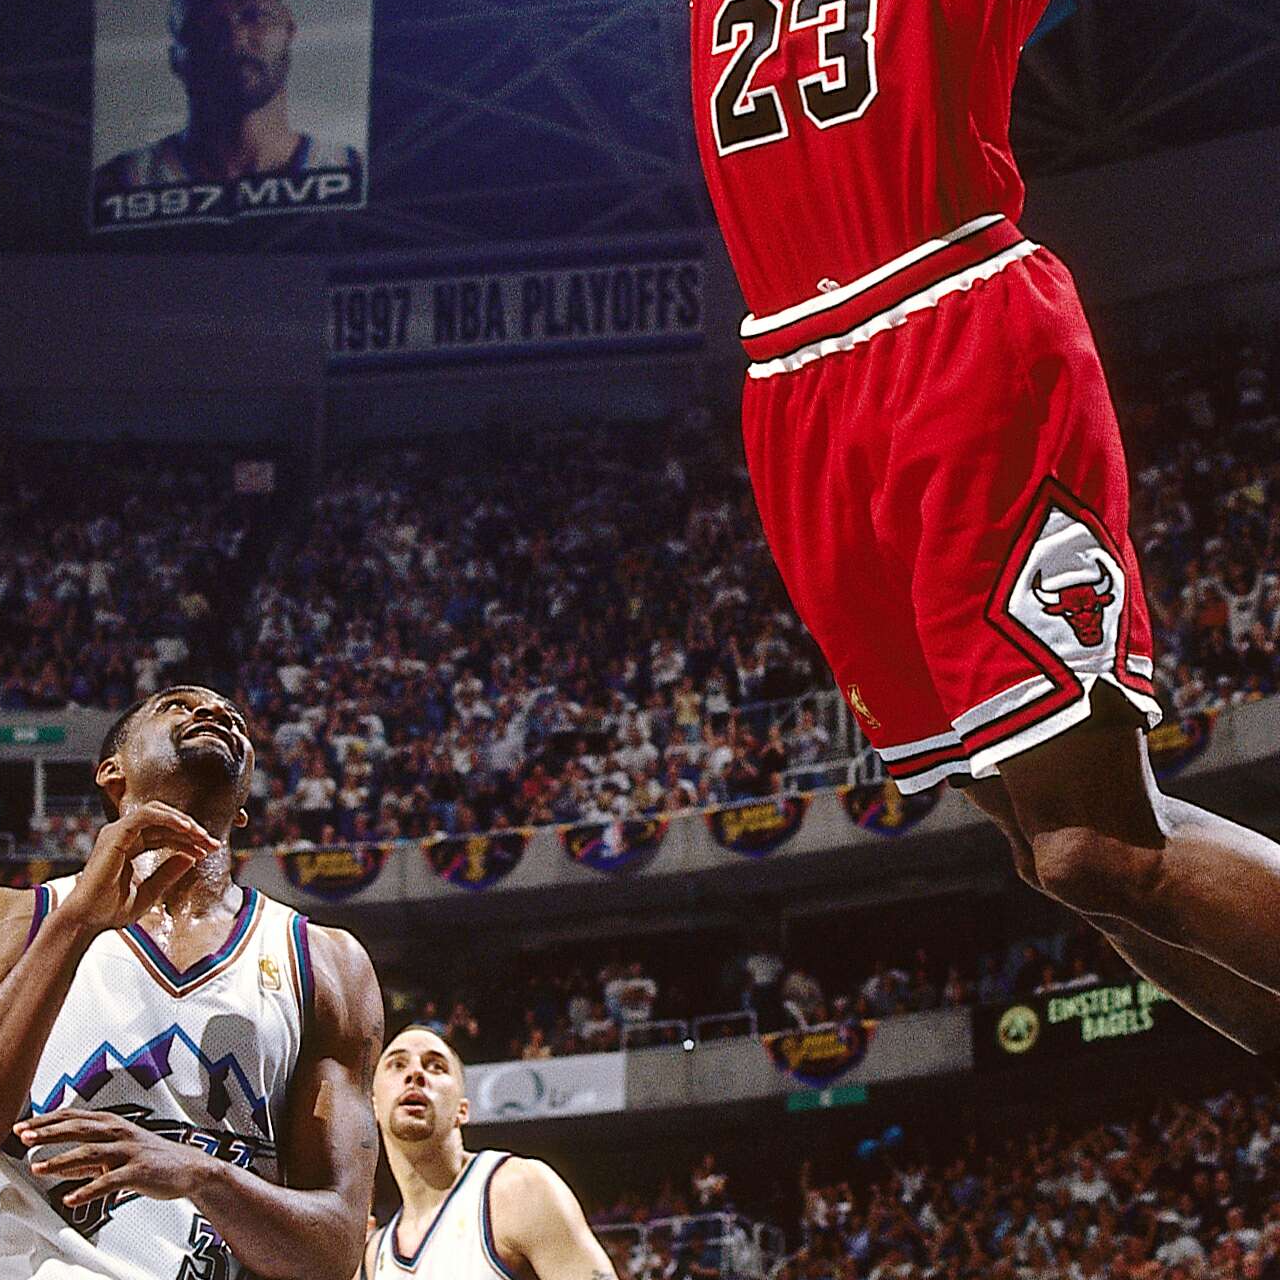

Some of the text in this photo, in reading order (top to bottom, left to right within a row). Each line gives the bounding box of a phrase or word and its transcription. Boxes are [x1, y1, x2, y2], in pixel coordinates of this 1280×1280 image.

[103, 173, 351, 219] 1997 MVP
[329, 264, 700, 352] 1997 NBA PLAYOFFS
